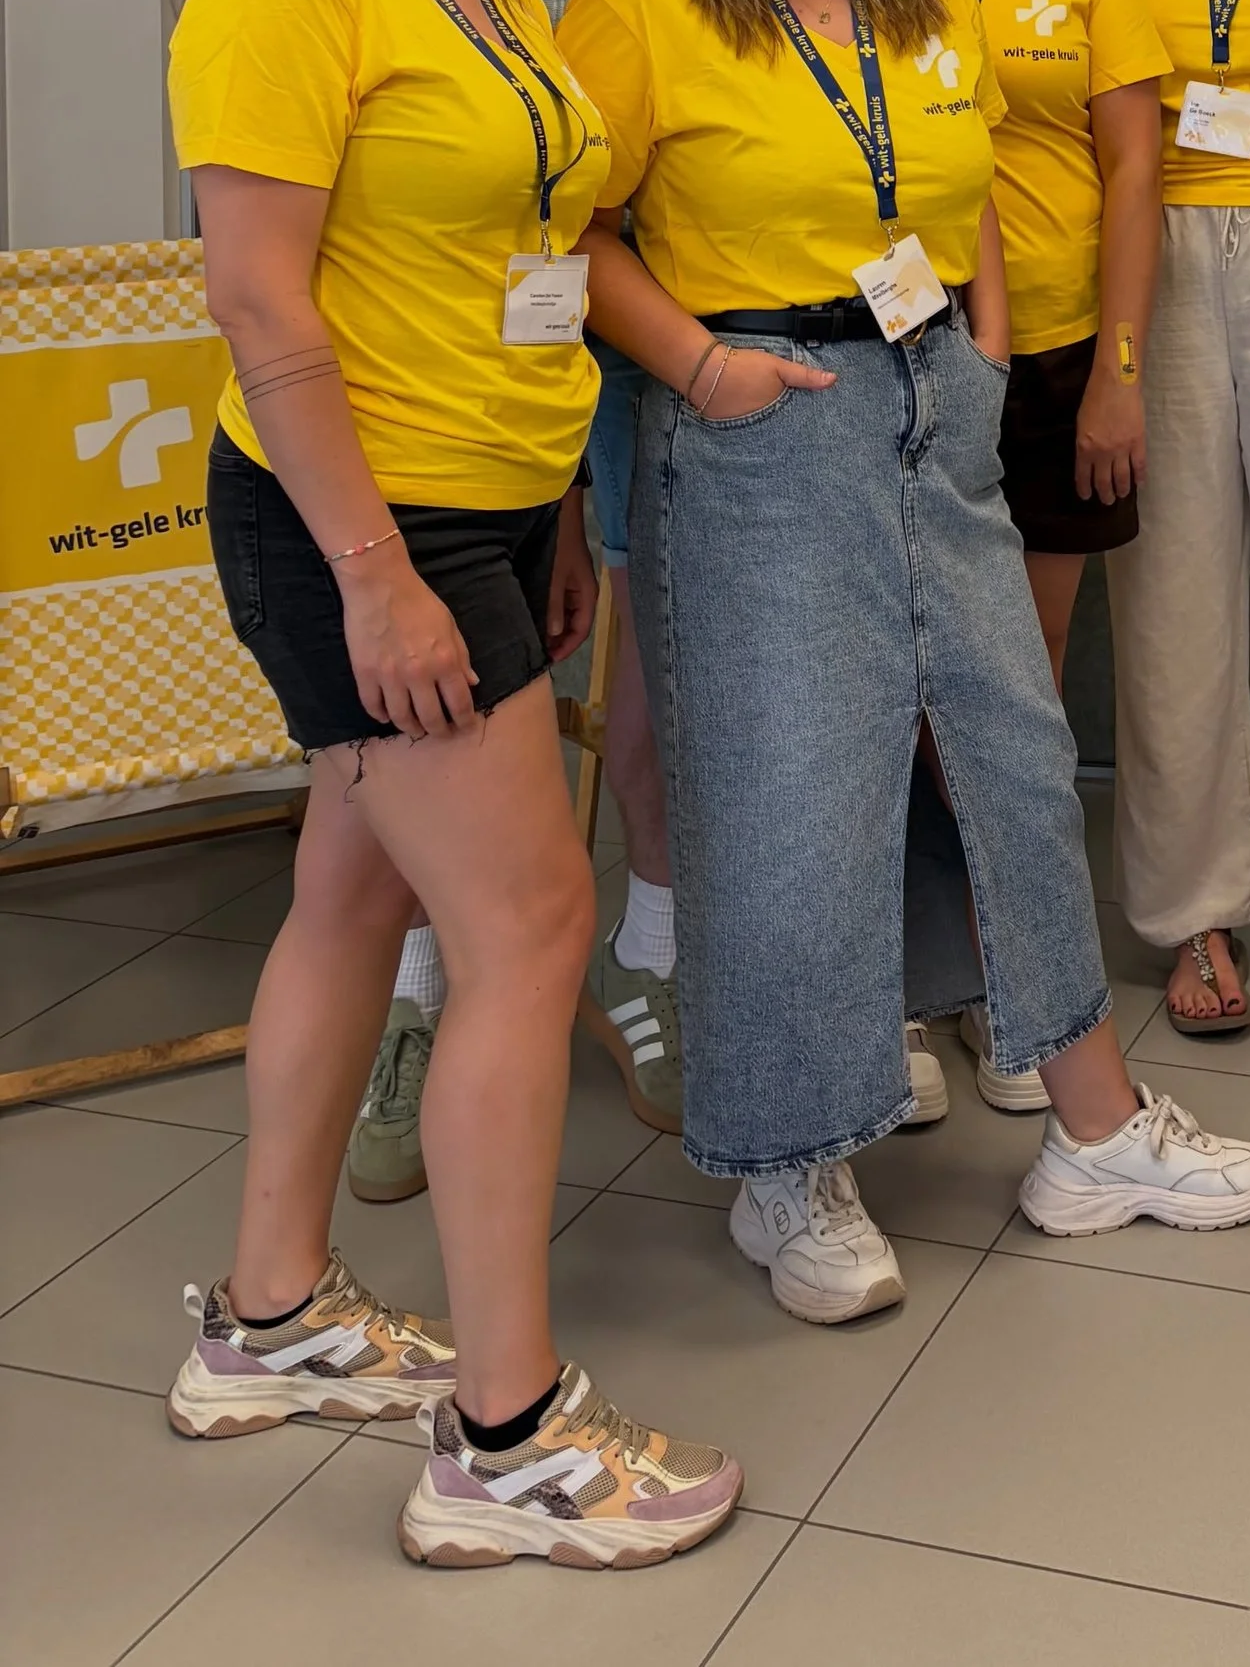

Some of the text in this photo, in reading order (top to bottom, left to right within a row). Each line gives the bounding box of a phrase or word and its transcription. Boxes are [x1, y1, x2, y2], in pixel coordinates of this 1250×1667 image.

[455, 13, 480, 40] kruis
[796, 31, 817, 62] kruis
[1003, 46, 1079, 62] wit-gele kruis
[923, 98, 972, 116] wit-gele
[869, 96, 889, 169] wit-gele kruis
[49, 512, 170, 554] wit-gele
